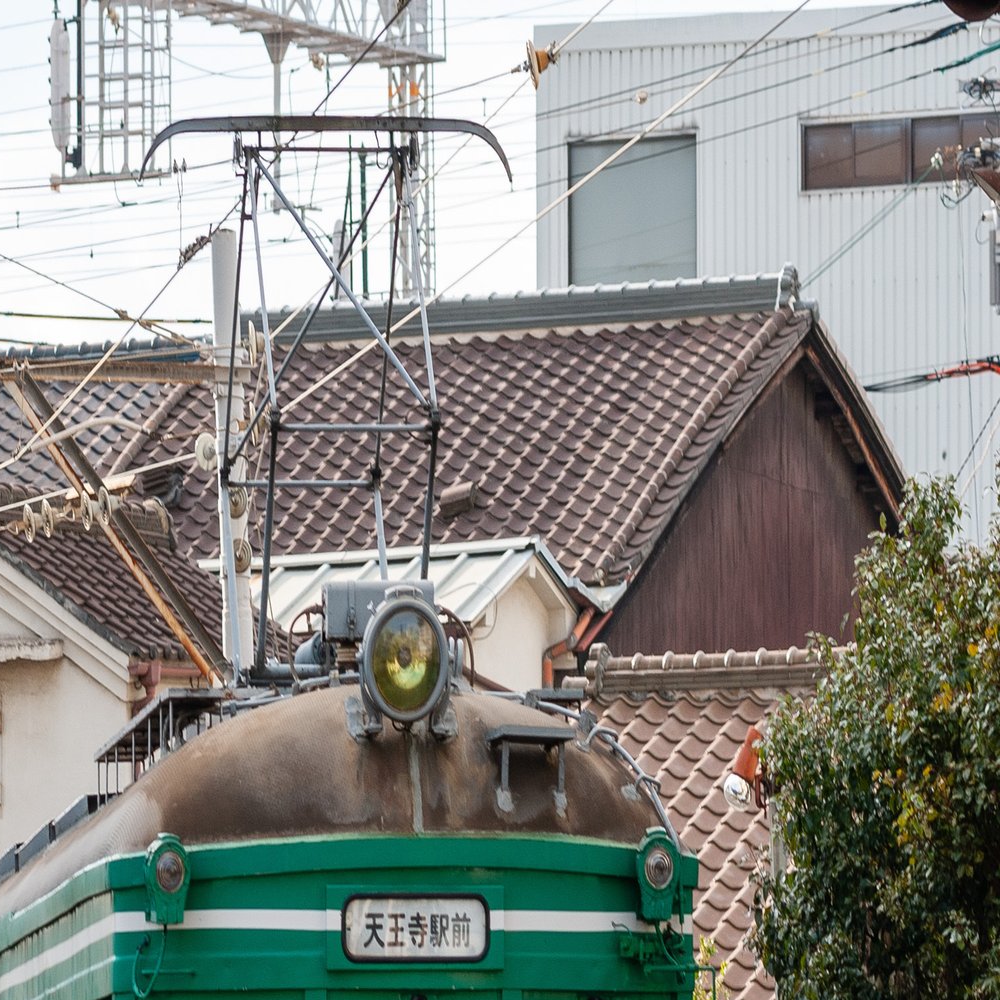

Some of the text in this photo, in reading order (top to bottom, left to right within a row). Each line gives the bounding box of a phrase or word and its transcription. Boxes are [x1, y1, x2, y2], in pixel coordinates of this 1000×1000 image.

[363, 911, 471, 948] 天王寺駅前
